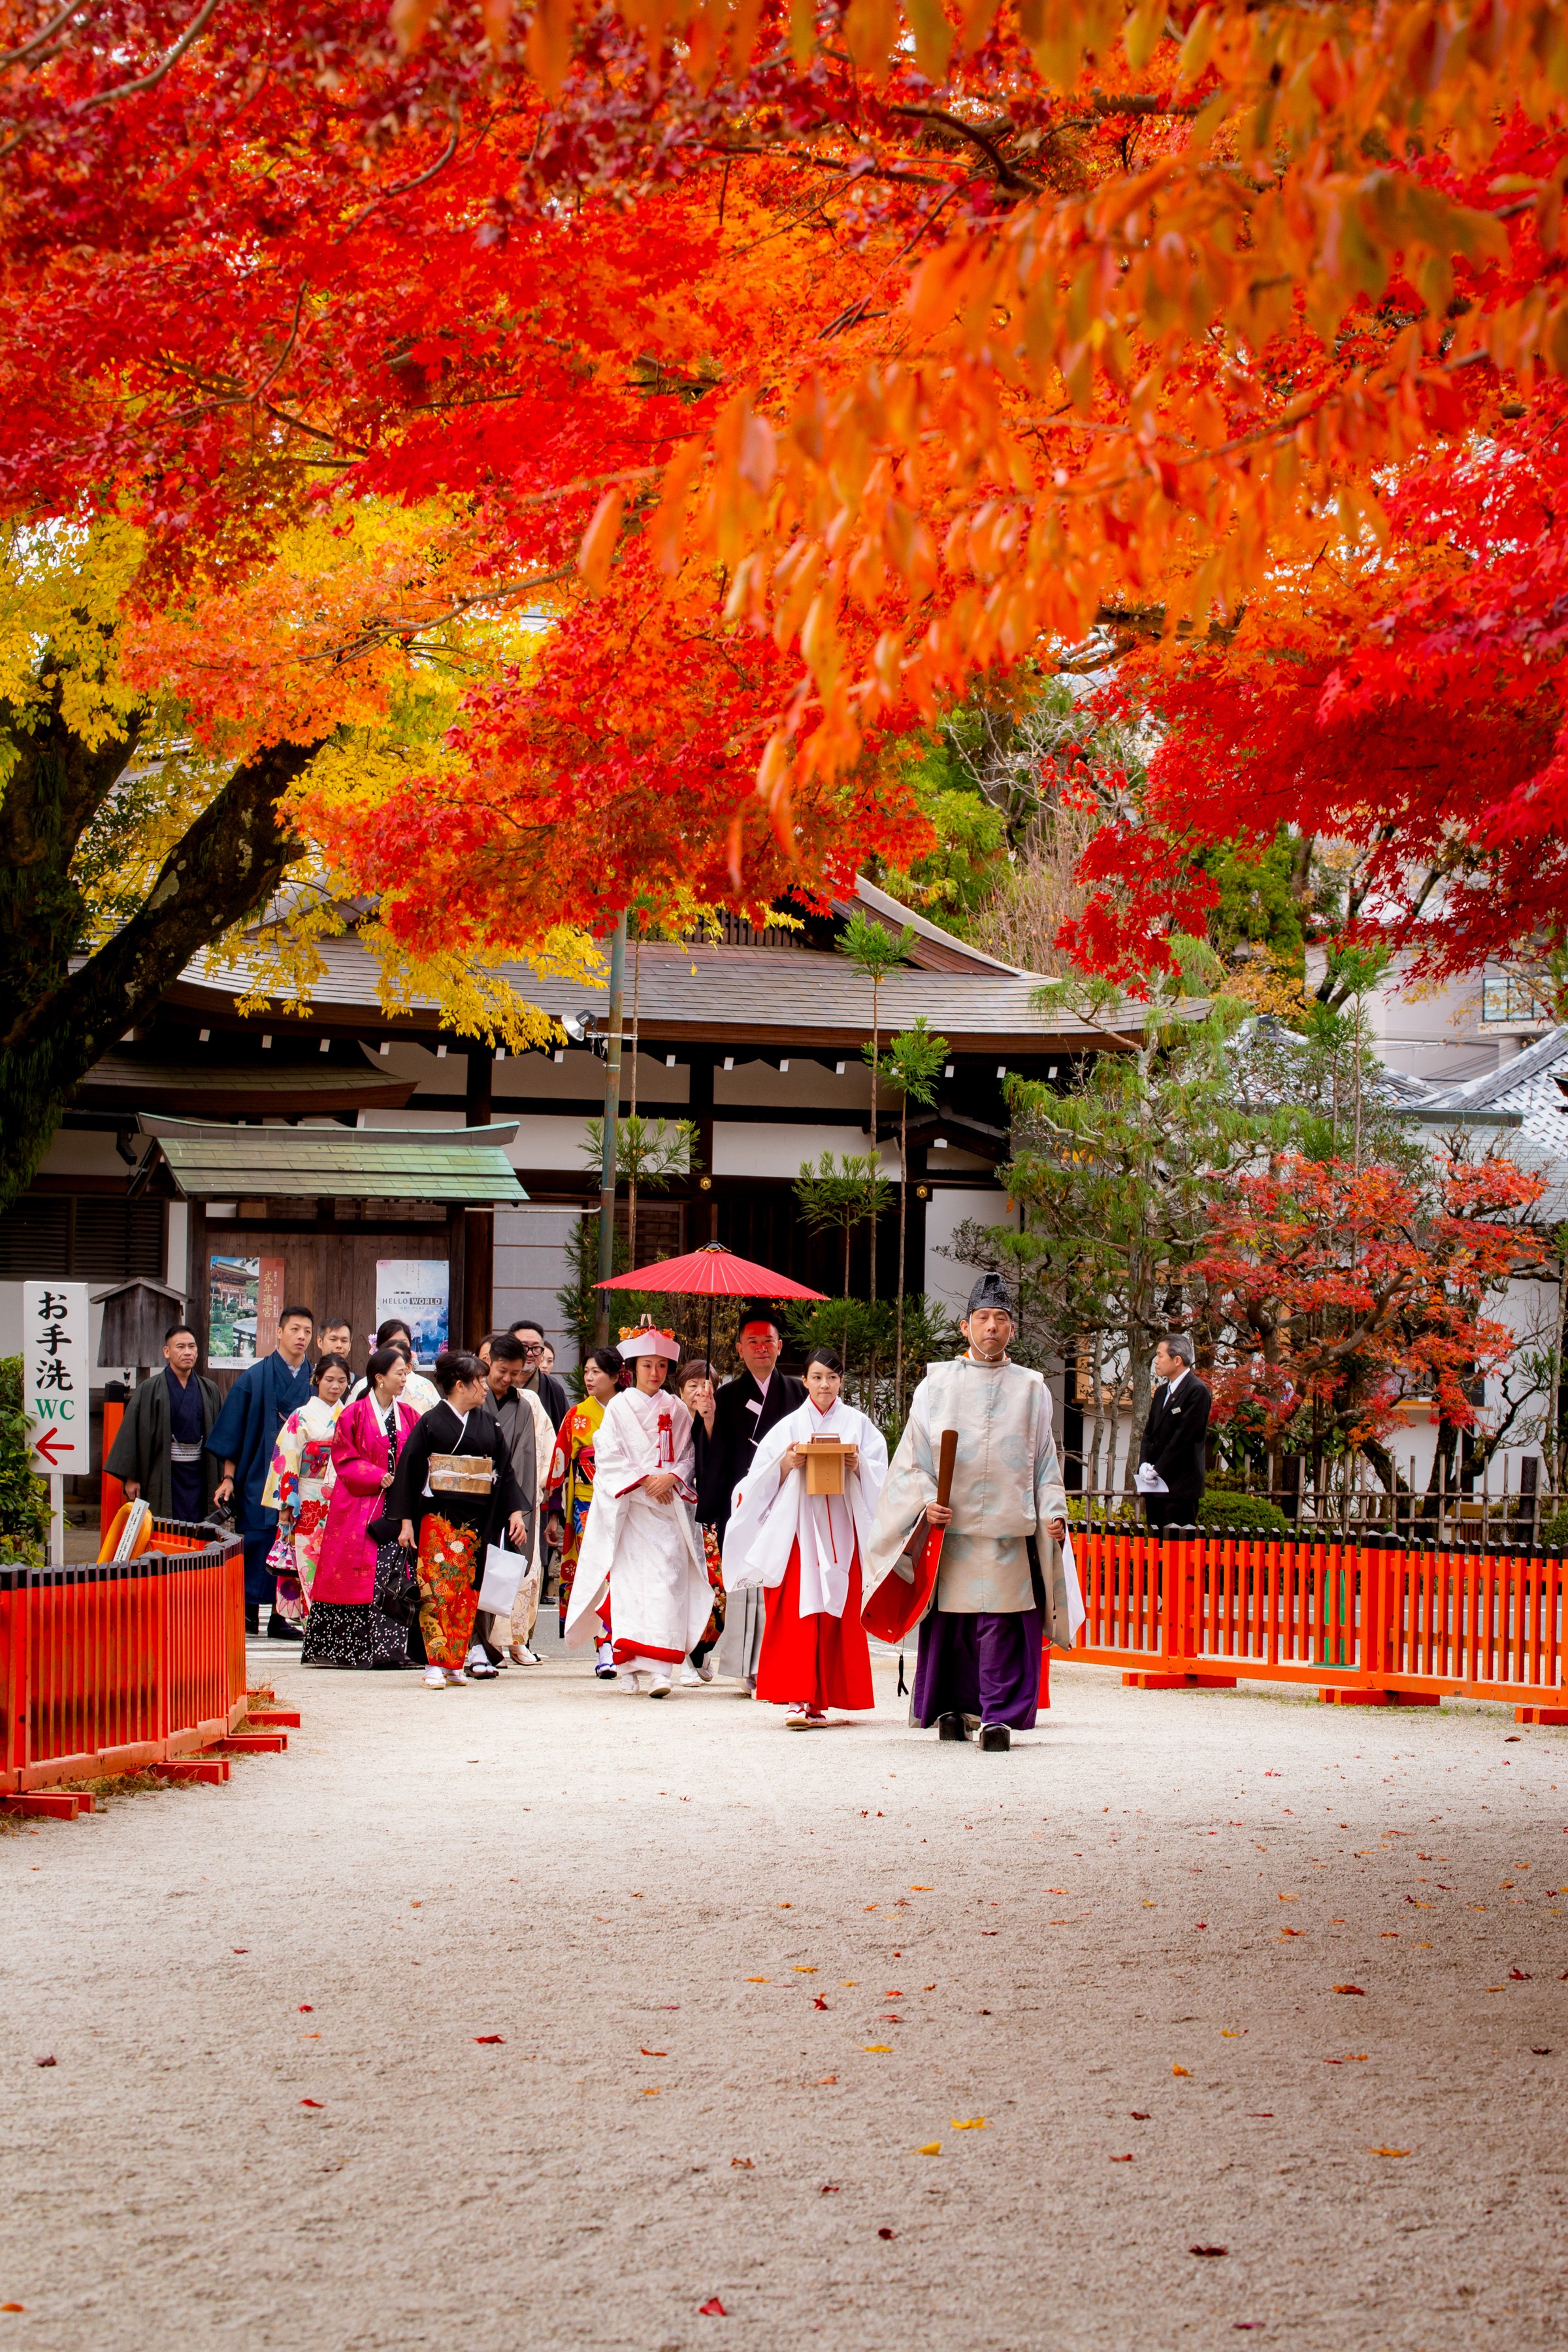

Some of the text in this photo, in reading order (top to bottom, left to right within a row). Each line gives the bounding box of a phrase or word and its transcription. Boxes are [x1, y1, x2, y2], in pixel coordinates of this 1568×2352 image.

[35, 1291, 74, 1392] お手洗
[35, 1399, 75, 1420] WC
